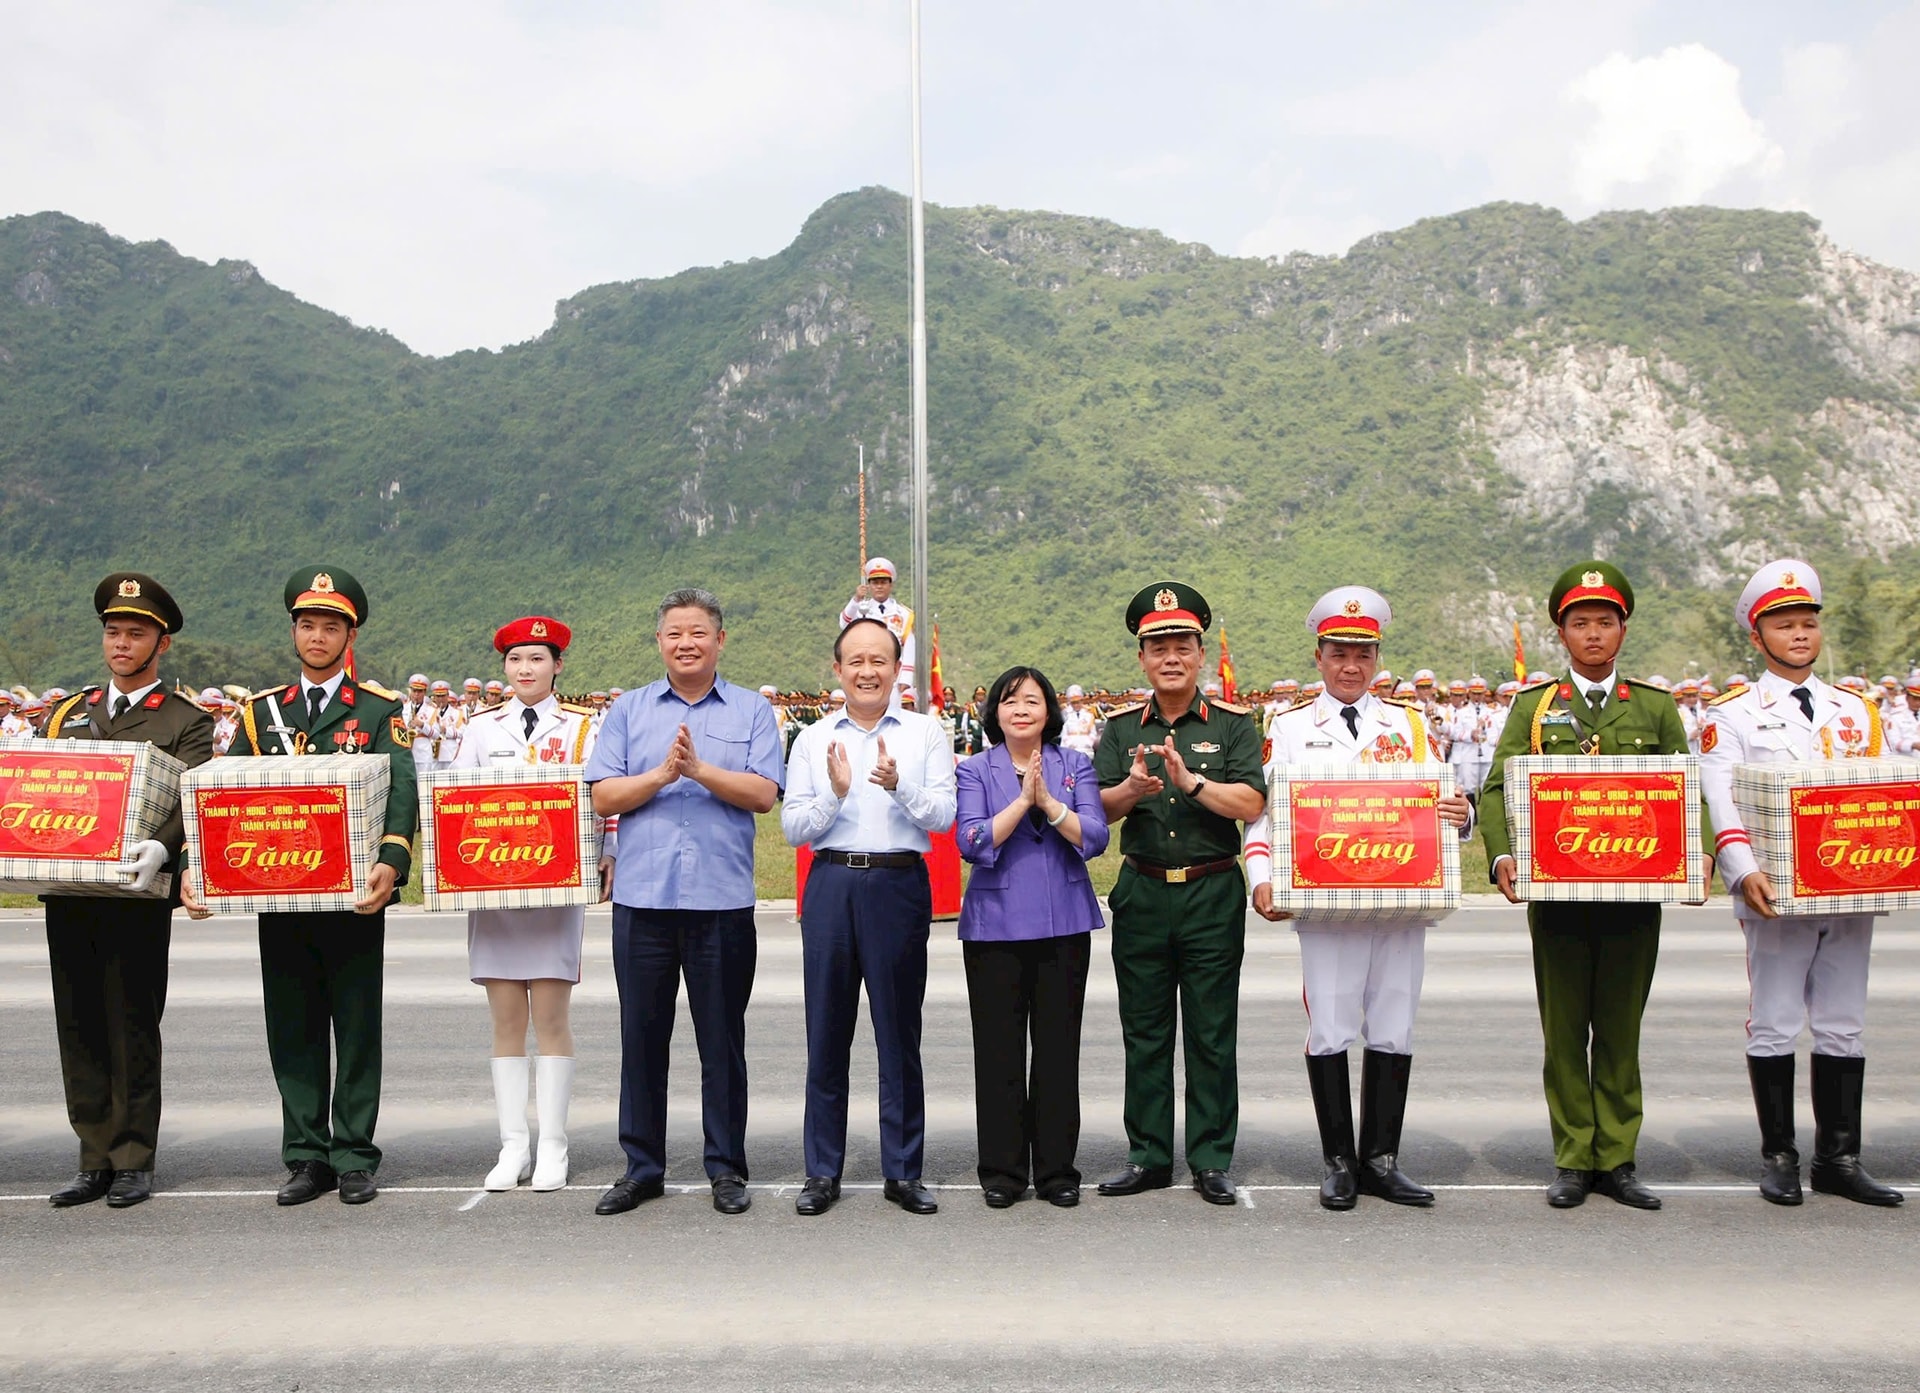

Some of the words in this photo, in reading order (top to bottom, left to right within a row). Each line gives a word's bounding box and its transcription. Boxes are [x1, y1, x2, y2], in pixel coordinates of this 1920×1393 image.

[0, 766, 14, 778] ÀNH
[84, 770, 94, 780] UB
[95, 770, 124, 782] MTTQVN
[46, 782, 61, 793] PHỐ
[63, 784, 73, 794] HÀ
[74, 784, 88, 796] NỘI
[1635, 790, 1645, 800] UB
[1648, 790, 1678, 802] MTTQVN
[299, 805, 309, 814] UB
[311, 804, 340, 814] MTTQVN
[532, 800, 541, 810] UB
[543, 800, 571, 810] MTTQVN
[1392, 798, 1402, 807] UB
[1404, 798, 1433, 808] MTTQVN
[1599, 802, 1615, 816] PHỐ
[1617, 805, 1627, 816] HÀ
[1629, 805, 1642, 817] NỘI
[1893, 801, 1904, 810] UB
[1905, 800, 1920, 809] MTT
[0, 802, 99, 836] Tặng
[499, 814, 513, 826] PHỐ
[515, 815, 525, 826] HÀ
[526, 814, 539, 827] NỘI
[1358, 810, 1372, 822] PHỐ
[1374, 811, 1384, 822] HÀ
[1386, 811, 1399, 824] NỘI
[1860, 816, 1874, 827] PHỐ
[1876, 816, 1886, 826] HÀ
[1888, 815, 1901, 827] NỘI
[266, 818, 280, 830] PHỐ
[282, 819, 292, 829] HÀ
[294, 818, 306, 831] NỘI
[1315, 833, 1418, 864] Tặng
[1554, 826, 1661, 859] Tặng
[224, 842, 326, 872] Tặng
[458, 838, 557, 867] Tặng
[1817, 840, 1919, 870] Tặng
